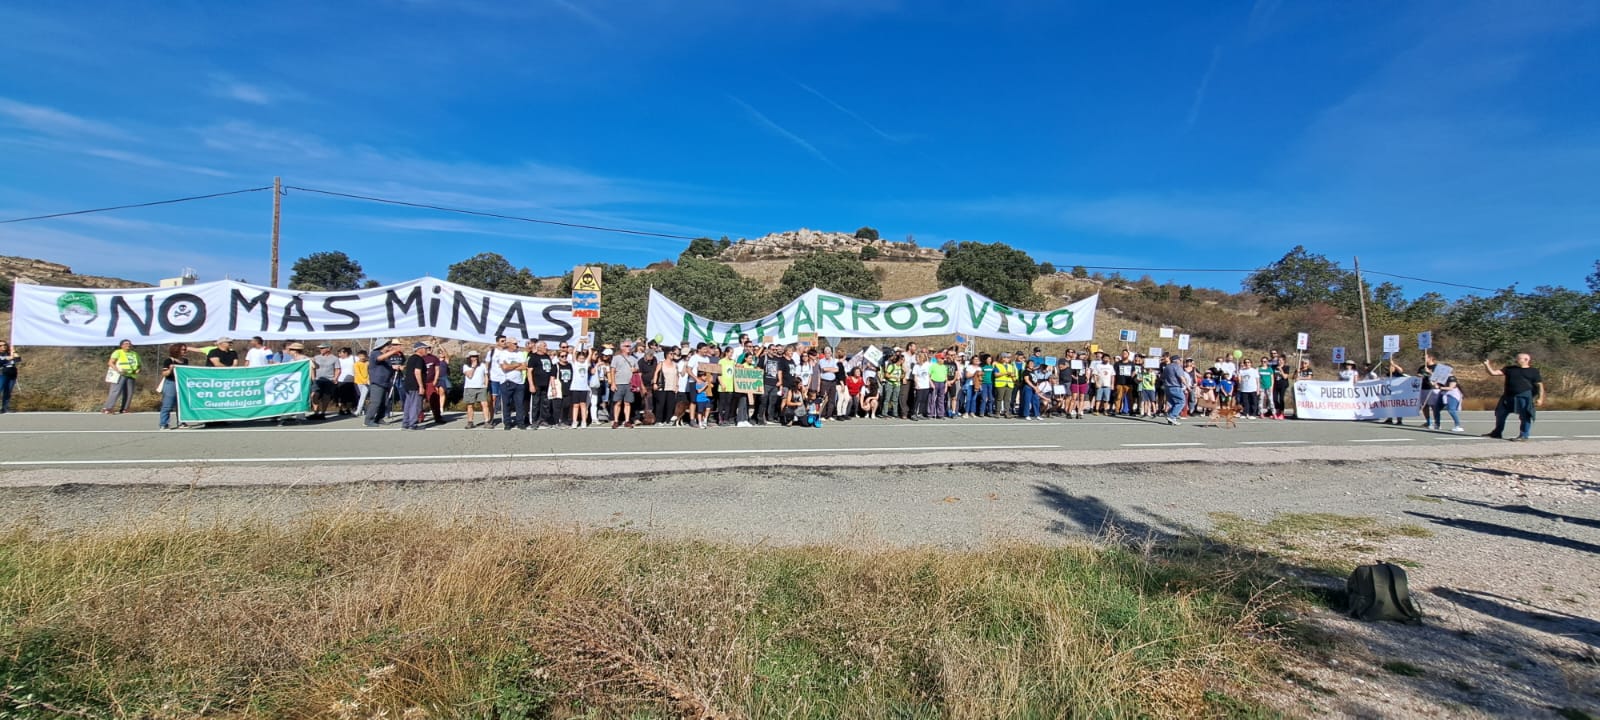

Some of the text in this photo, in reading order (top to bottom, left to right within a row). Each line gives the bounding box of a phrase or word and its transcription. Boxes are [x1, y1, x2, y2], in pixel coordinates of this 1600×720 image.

[106, 292, 207, 338] NO
[682, 294, 950, 347] NAHARROS
[186, 379, 261, 390] ecologistas
[217, 388, 261, 398] acción
[1320, 384, 1392, 399] PUEBLOS VIVOS
[204, 399, 262, 408] Guadalajara
[1297, 398, 1419, 410] PARA LAS PERSONAS Y LA NATURALEZ
